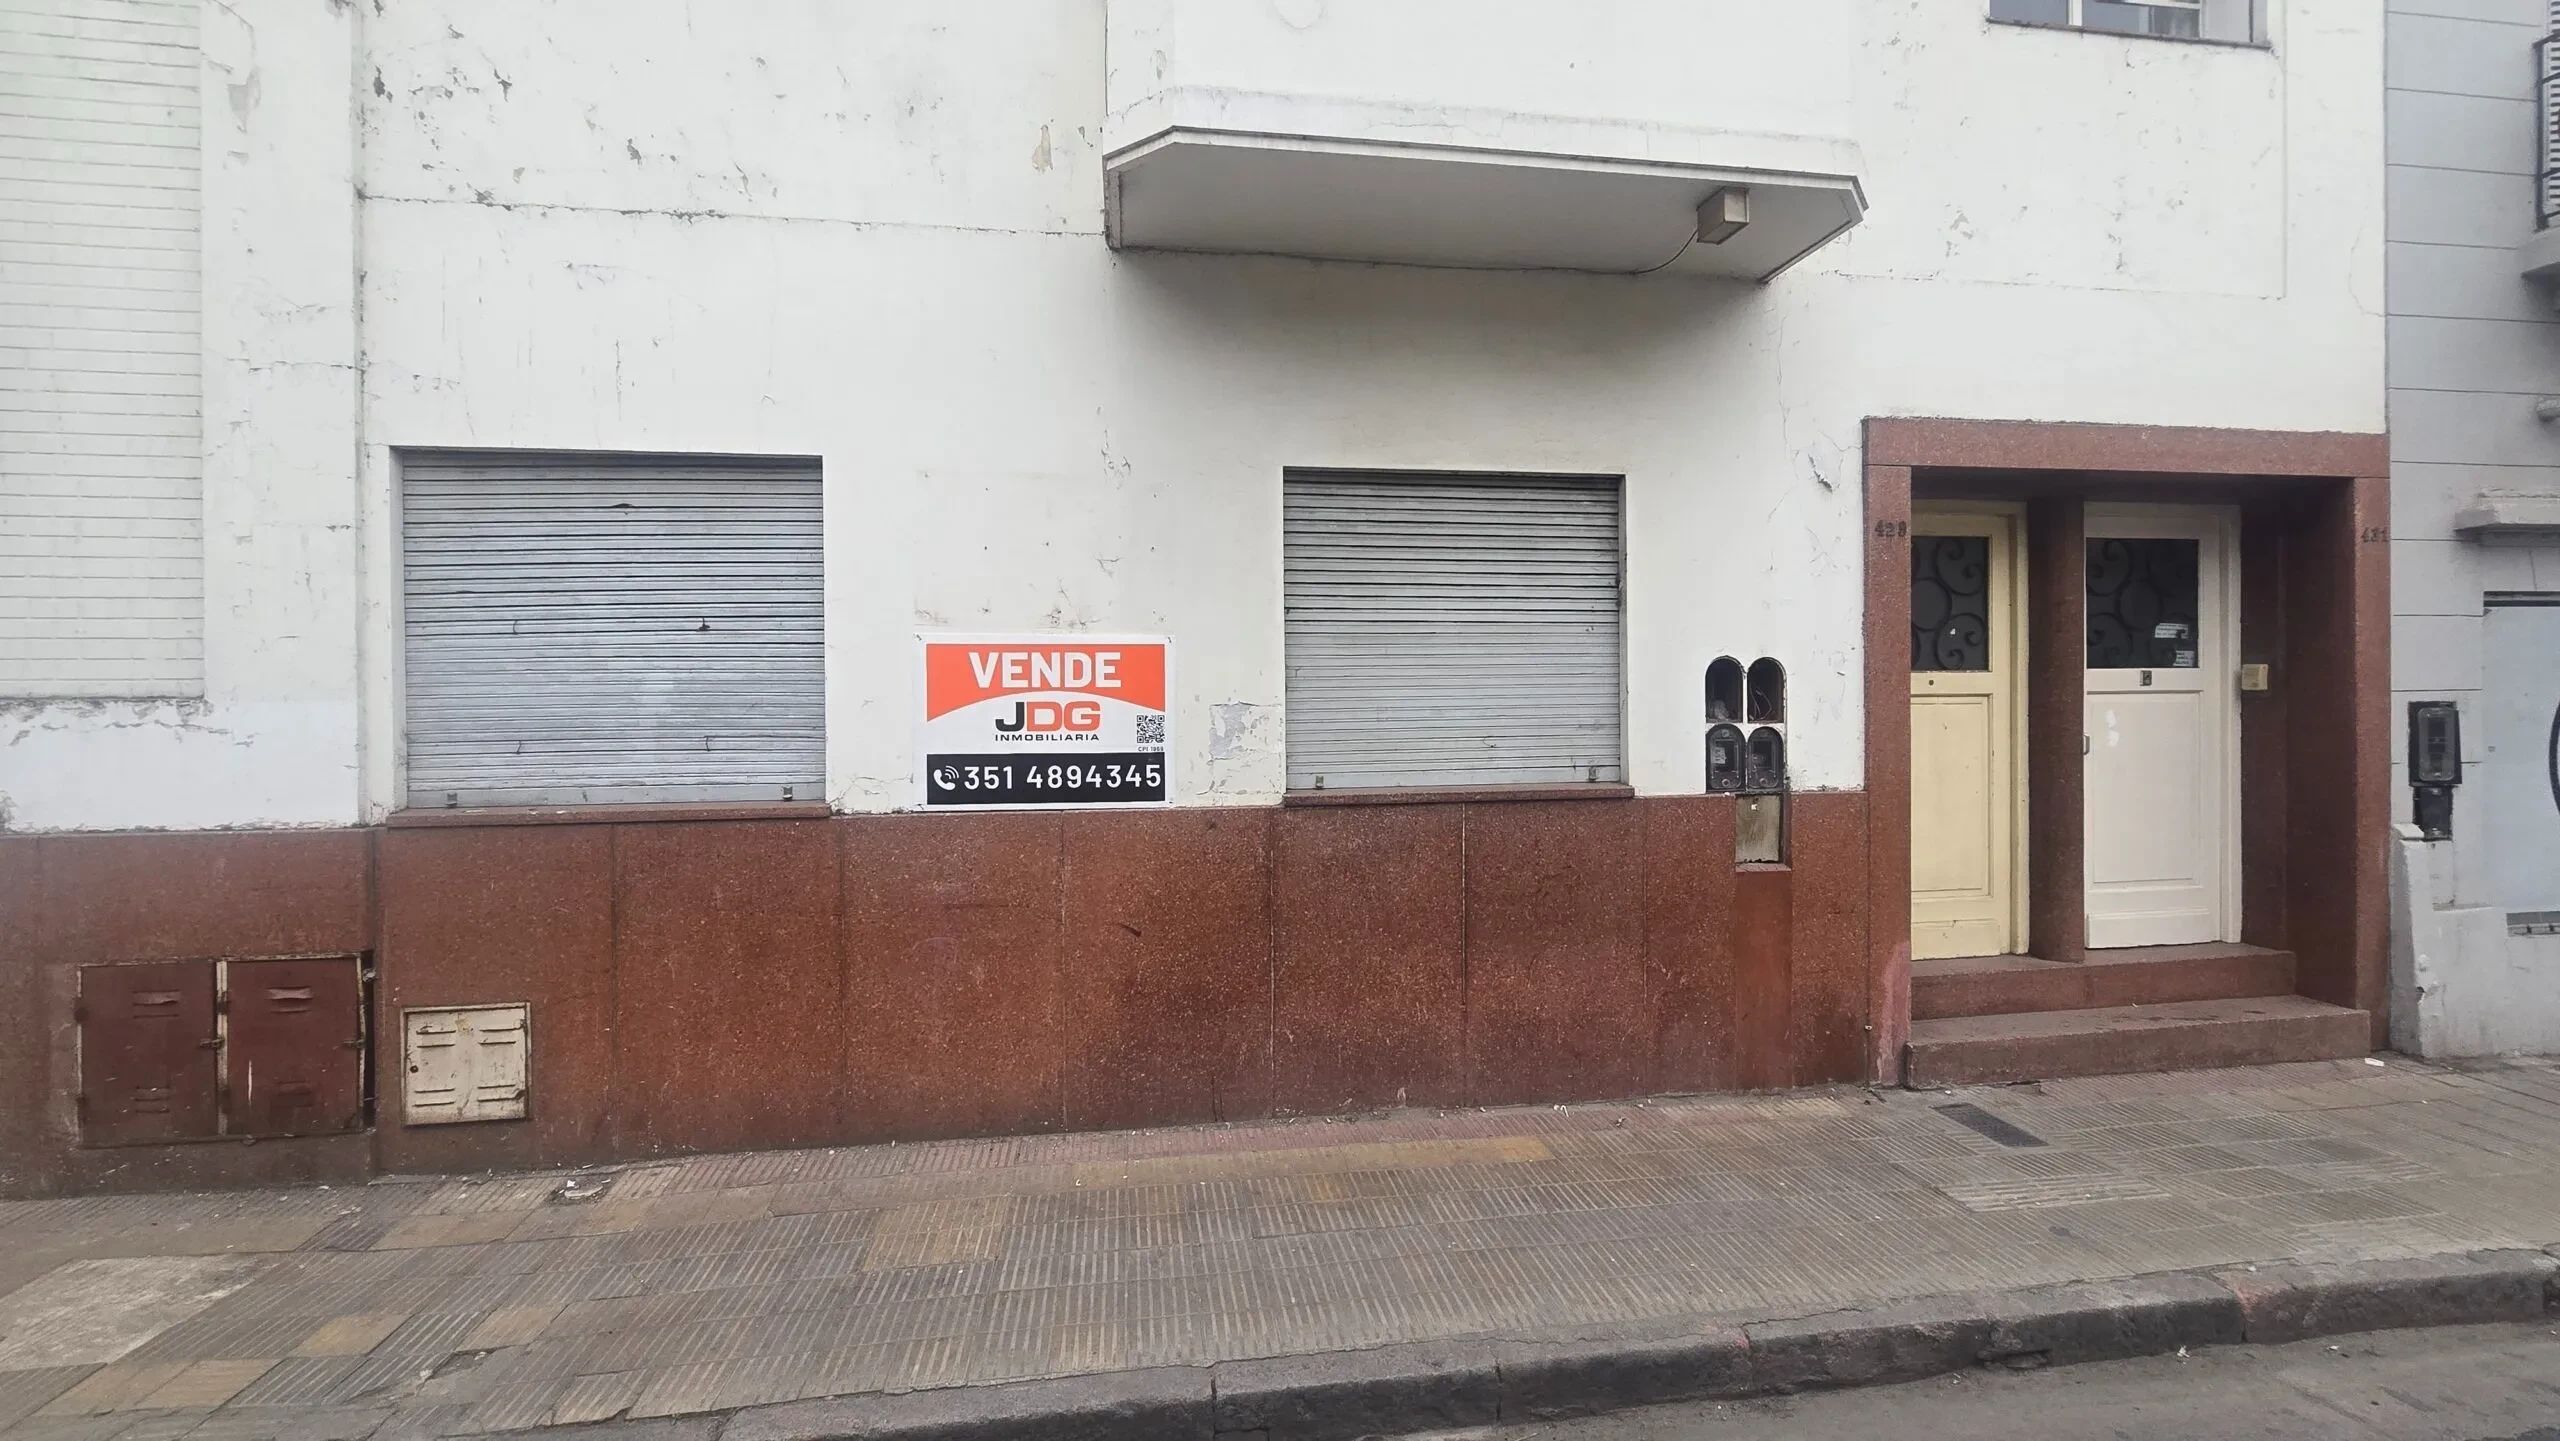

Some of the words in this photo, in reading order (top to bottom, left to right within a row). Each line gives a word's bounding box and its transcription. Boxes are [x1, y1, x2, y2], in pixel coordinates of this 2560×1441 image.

[968, 651, 1121, 688] VENDE
[995, 701, 1101, 731] JDG
[995, 733, 1099, 741] INMOBILIARIA
[964, 766, 1012, 790] 351
[1026, 764, 1161, 789] 4894345
